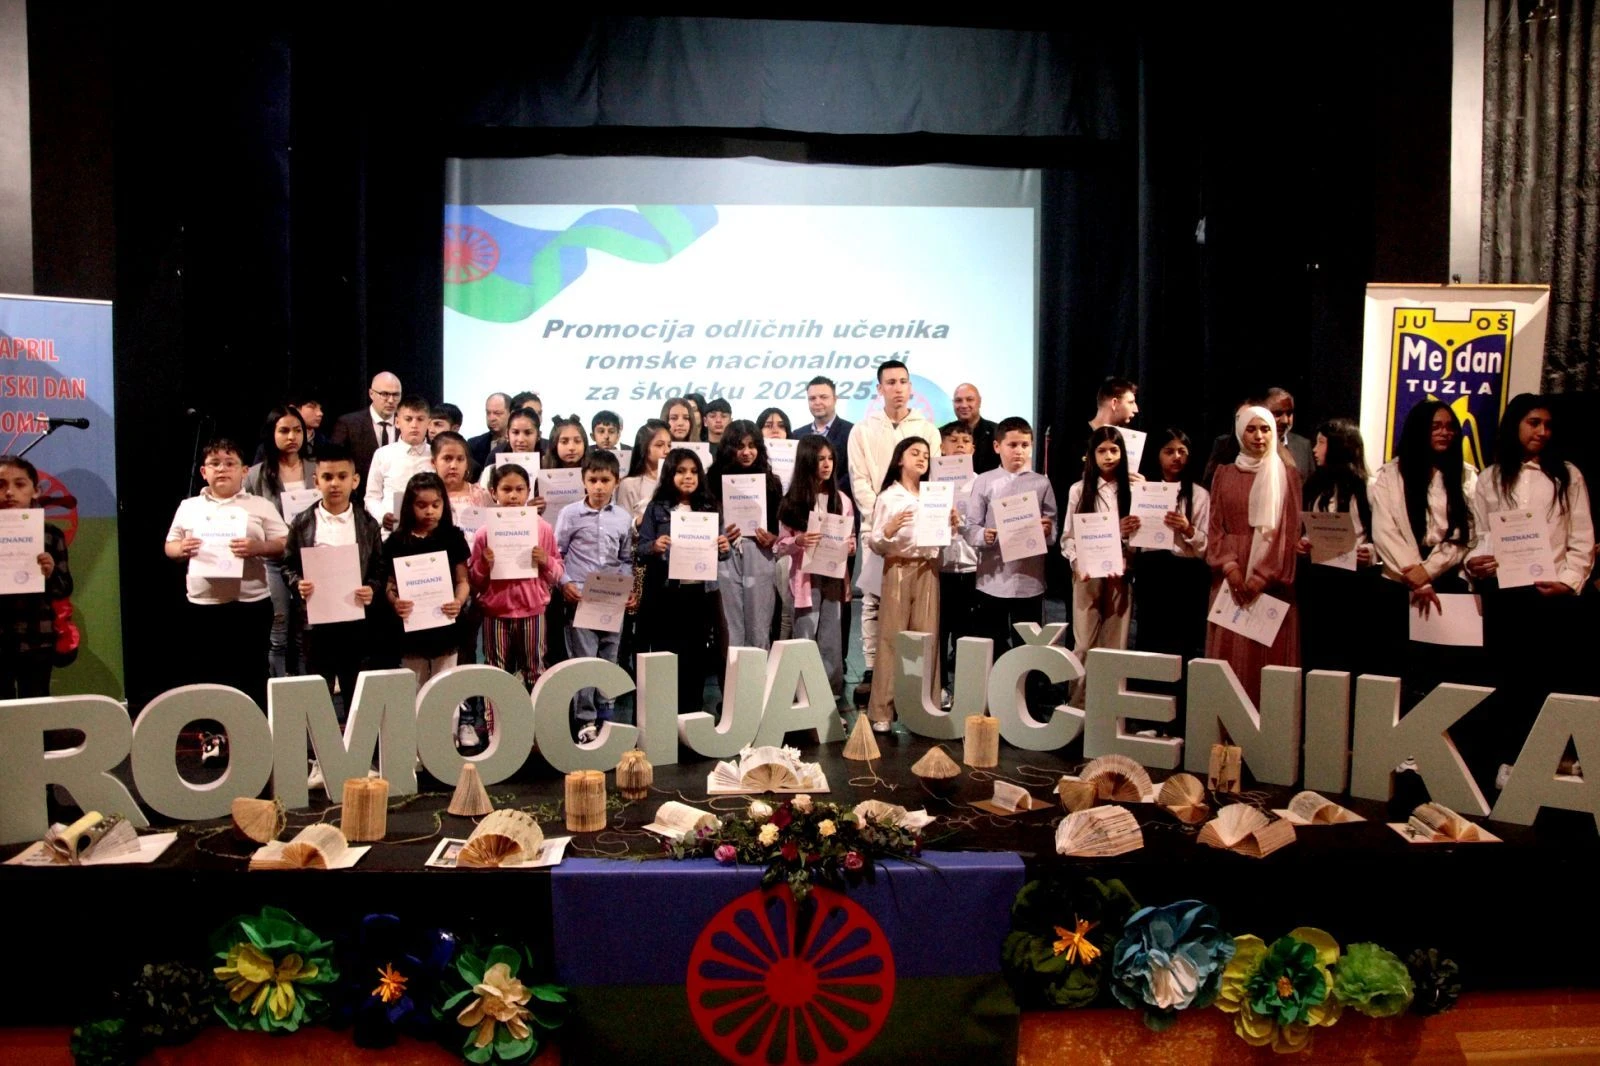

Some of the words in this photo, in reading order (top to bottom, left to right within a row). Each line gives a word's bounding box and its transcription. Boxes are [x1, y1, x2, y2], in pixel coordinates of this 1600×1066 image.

[542, 319, 696, 343] Promocija
[704, 319, 824, 339] odličnih
[832, 319, 951, 339] učenika
[1398, 315, 1427, 329] JU
[1476, 314, 1509, 331] OŠ
[0, 337, 60, 361] APRIL
[585, 350, 697, 370] romske
[706, 350, 911, 370] nacionalnosti
[44, 377, 86, 400] DAN
[585, 386, 620, 401] za
[629, 381, 745, 401] školsku
[1406, 379, 1493, 396] TUZLA
[1501, 532, 1539, 542] PRIZNANJE
[406, 576, 442, 587] PRIZNANJE
[0, 638, 846, 845] ROMOCIJA
[893, 622, 1600, 826] UČENIKA
